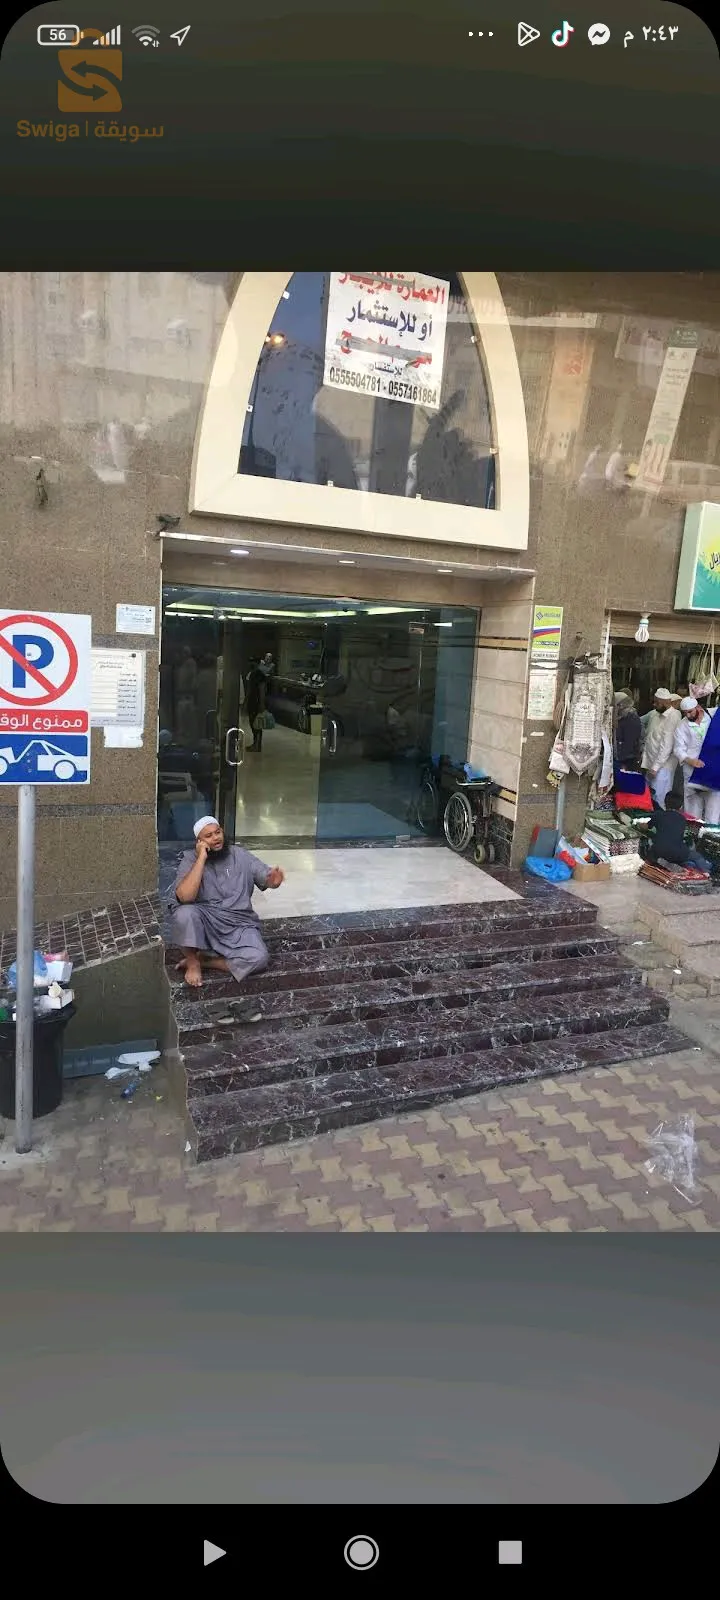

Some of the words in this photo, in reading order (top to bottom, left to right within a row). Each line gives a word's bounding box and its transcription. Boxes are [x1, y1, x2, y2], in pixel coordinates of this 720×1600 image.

[49, 29, 67, 41] 56
[623, 30, 635, 48] م
[642, 25, 679, 41] ٢:٤٣
[346, 300, 417, 337] للإستثمار
[418, 314, 433, 341] أو
[329, 366, 381, 392] 0555504781
[388, 380, 437, 404] 0557161864
[12, 634, 55, 689] P
[32, 715, 83, 730] ممنوع
